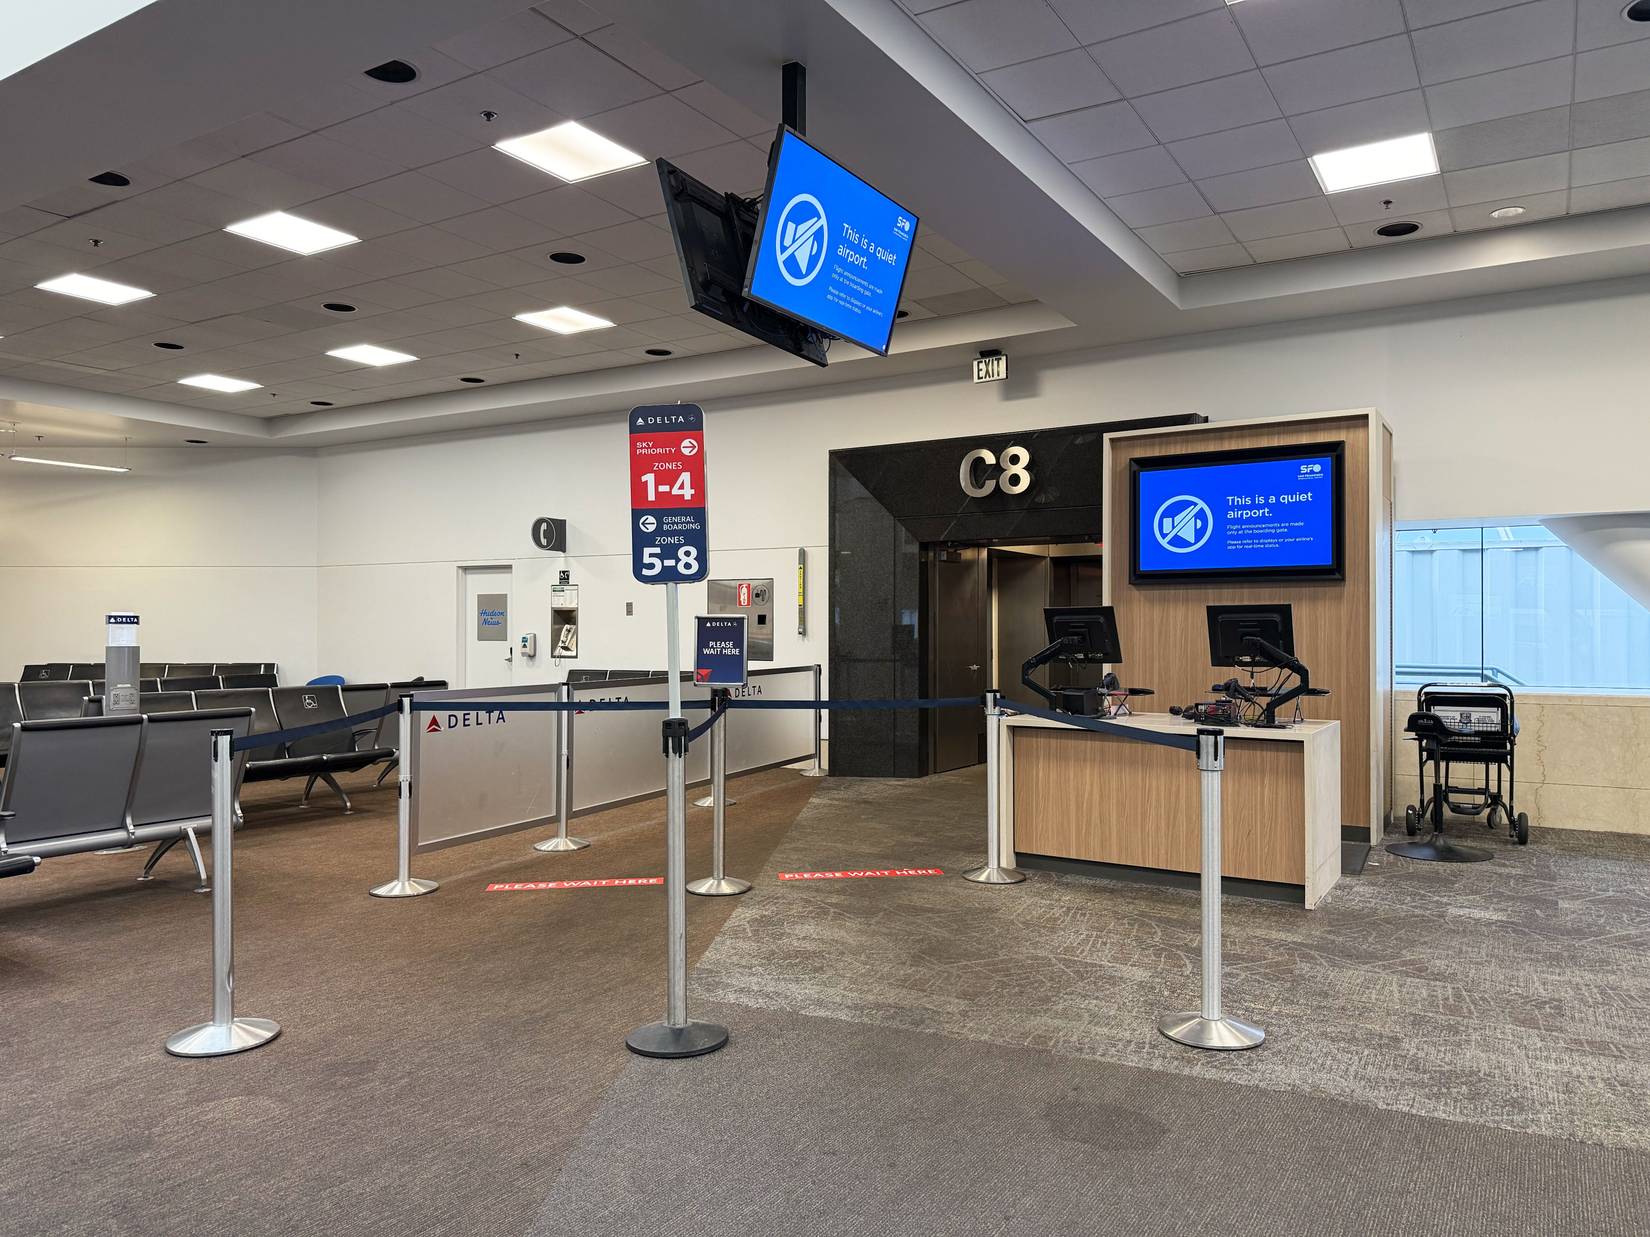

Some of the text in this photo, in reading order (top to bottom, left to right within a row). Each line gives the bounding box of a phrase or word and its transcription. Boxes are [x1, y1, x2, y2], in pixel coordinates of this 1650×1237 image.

[843, 222, 896, 266] This is a quiet
[838, 244, 868, 270] airport.
[977, 358, 1002, 380] EXIT
[648, 416, 684, 424] DELTA
[653, 462, 682, 470] ZONES
[960, 446, 1031, 498] C8
[642, 472, 694, 500] 1-4
[1226, 492, 1312, 506] This is a quiet
[1227, 507, 1272, 520] airport.
[655, 536, 684, 544] ZONES
[642, 546, 699, 576] 5-8
[722, 648, 740, 656] HERE
[734, 685, 762, 698] DELTA
[448, 710, 506, 729] DELTA
[784, 872, 844, 880] PLEASE
[494, 878, 658, 890] PLEASE WAIT HERE
